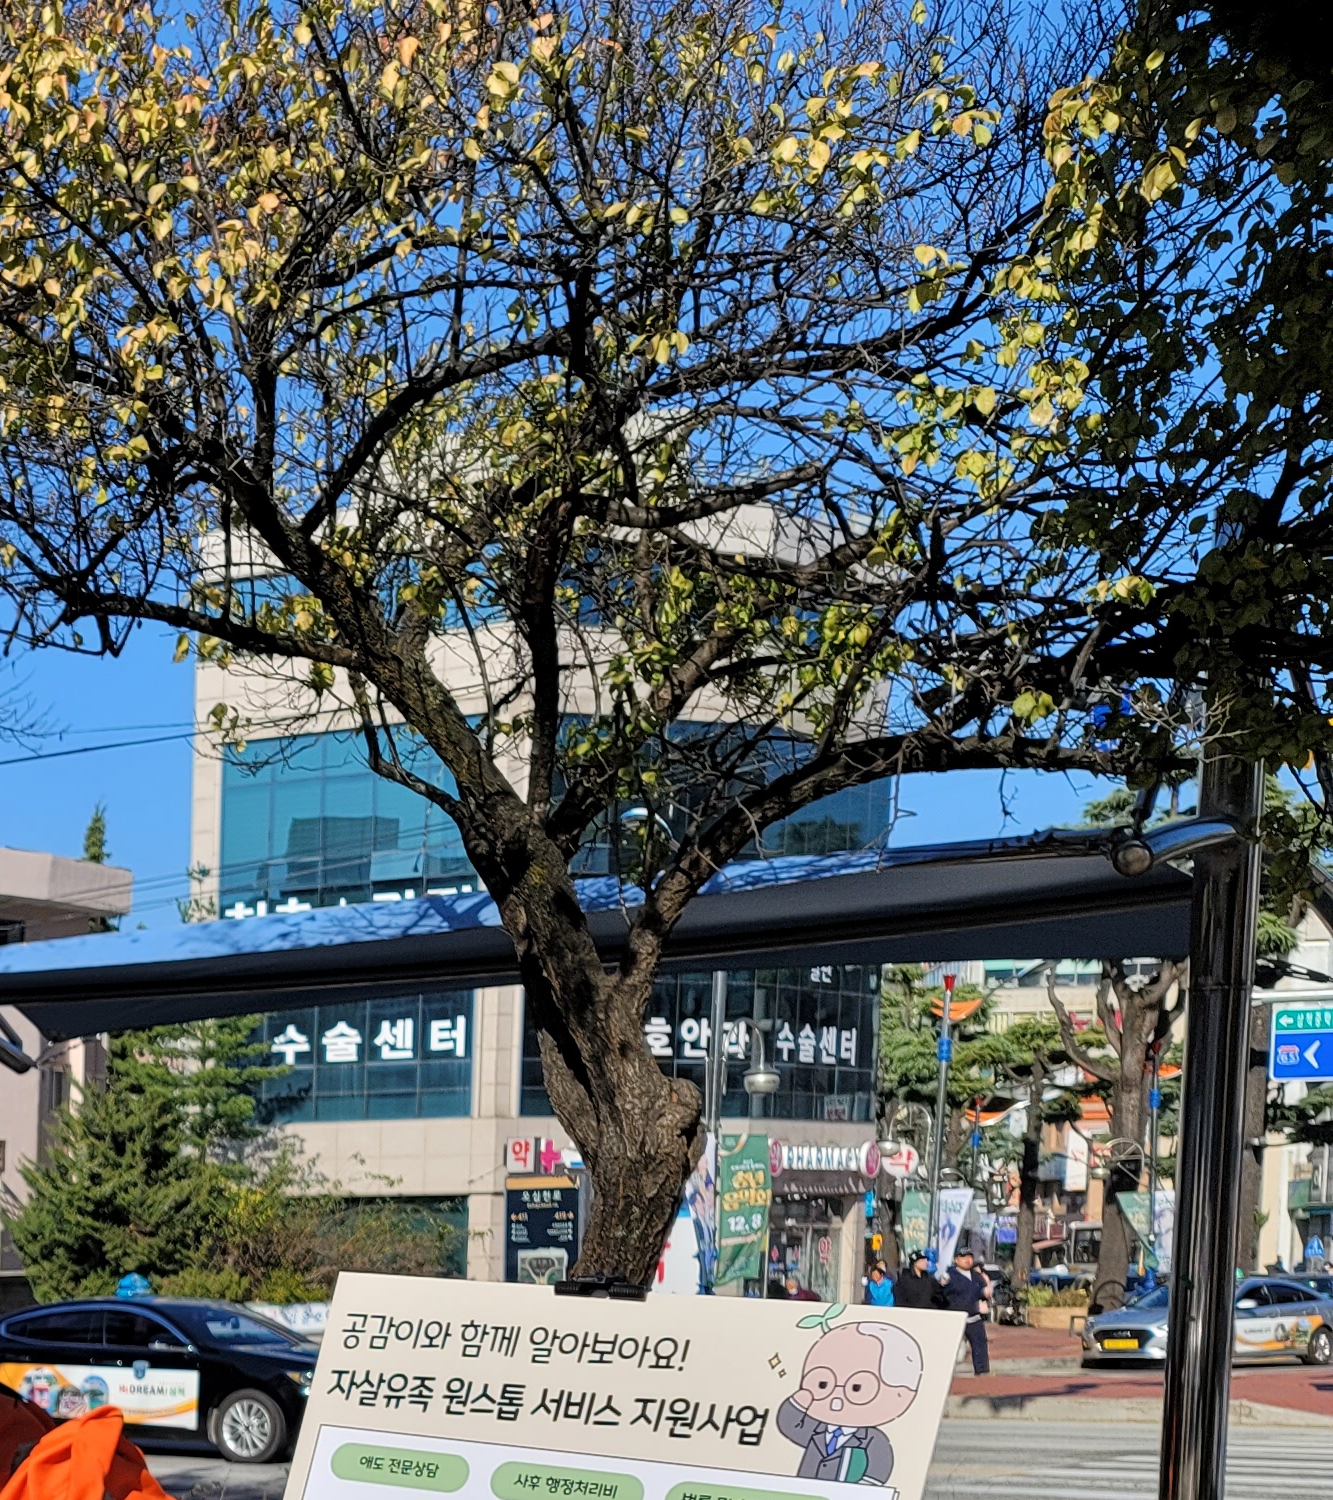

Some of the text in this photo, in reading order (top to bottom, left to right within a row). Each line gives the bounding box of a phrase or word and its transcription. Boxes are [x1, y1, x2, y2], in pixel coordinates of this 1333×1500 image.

[271, 1015, 467, 1066] 수술센터
[776, 1021, 857, 1067] 수술센터
[512, 1140, 530, 1168] 약
[342, 1313, 451, 1349] 공감이와
[461, 1320, 520, 1357] 함께
[529, 1327, 689, 1370] 알아보아요!
[327, 1369, 768, 1445] 자살유족 원스톱 서비스 지원사업
[359, 1456, 439, 1478] 애도 전문상담
[513, 1473, 617, 1498] 사후 행정처리비
